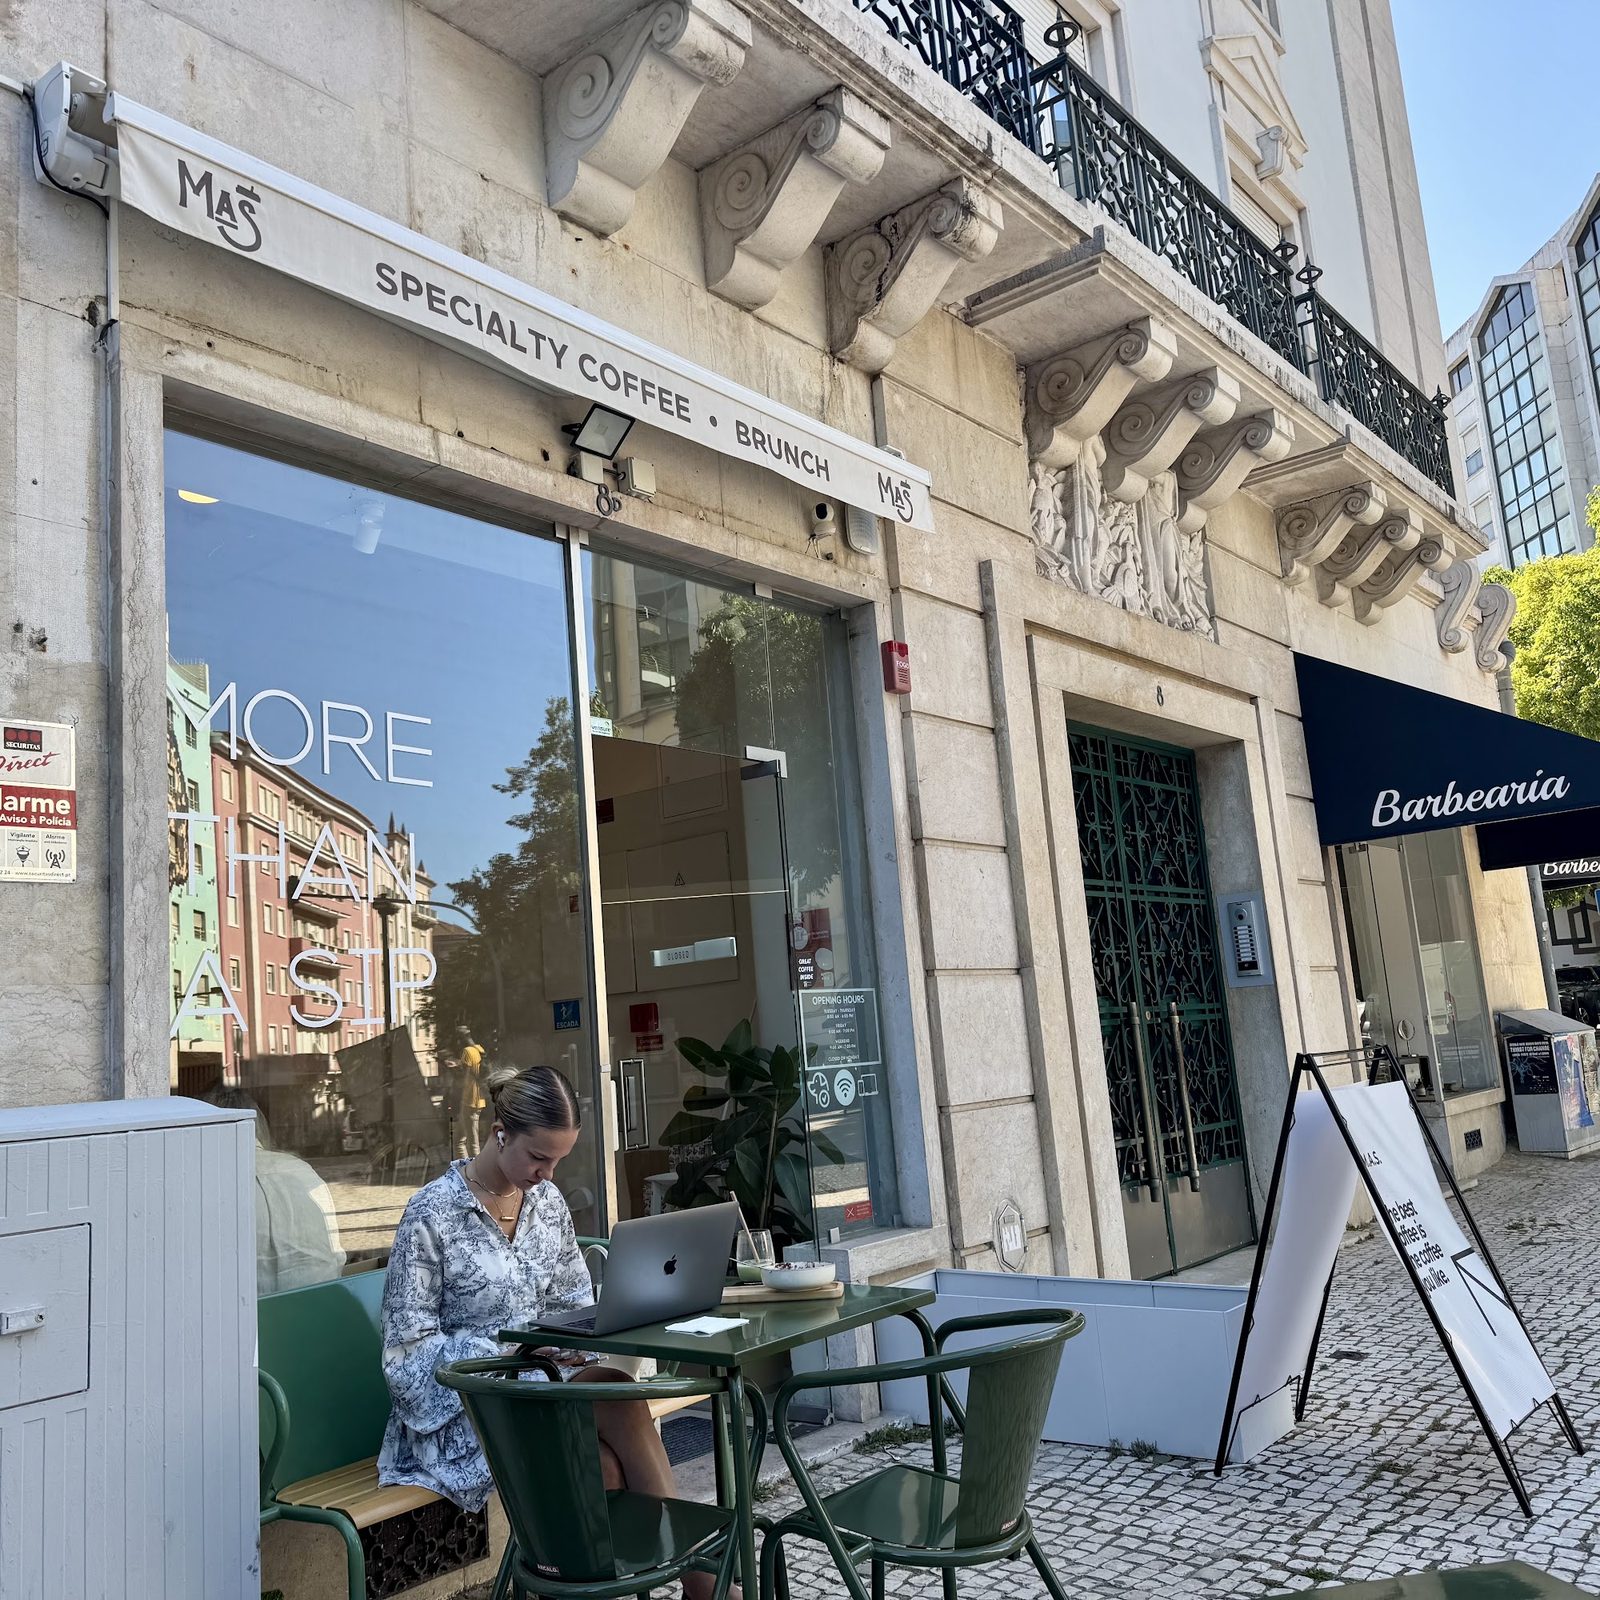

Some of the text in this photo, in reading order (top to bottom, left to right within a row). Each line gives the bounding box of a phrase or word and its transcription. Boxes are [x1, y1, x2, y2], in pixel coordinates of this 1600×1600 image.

[375, 262, 831, 482] SPECIALTY COFFEE BRUNCH
[896, 661, 909, 669] FOGO
[1157, 685, 1164, 706] 8
[6, 741, 40, 750] SECURITAS
[167, 682, 433, 788] MORE
[1371, 769, 1570, 827] Barbearia
[0, 813, 71, 826] Aviso à Polícia
[10, 832, 35, 840] Vigilante
[167, 811, 416, 904] THAN
[1543, 858, 1600, 875] Barbe
[169, 947, 438, 1036] A SIP
[812, 995, 865, 1005] OPENING HOURS
[557, 1020, 579, 1029] ESCADA
[1395, 1199, 1418, 1220] best
[1398, 1219, 1427, 1246] offee is
[1418, 1242, 1444, 1266] coffee
